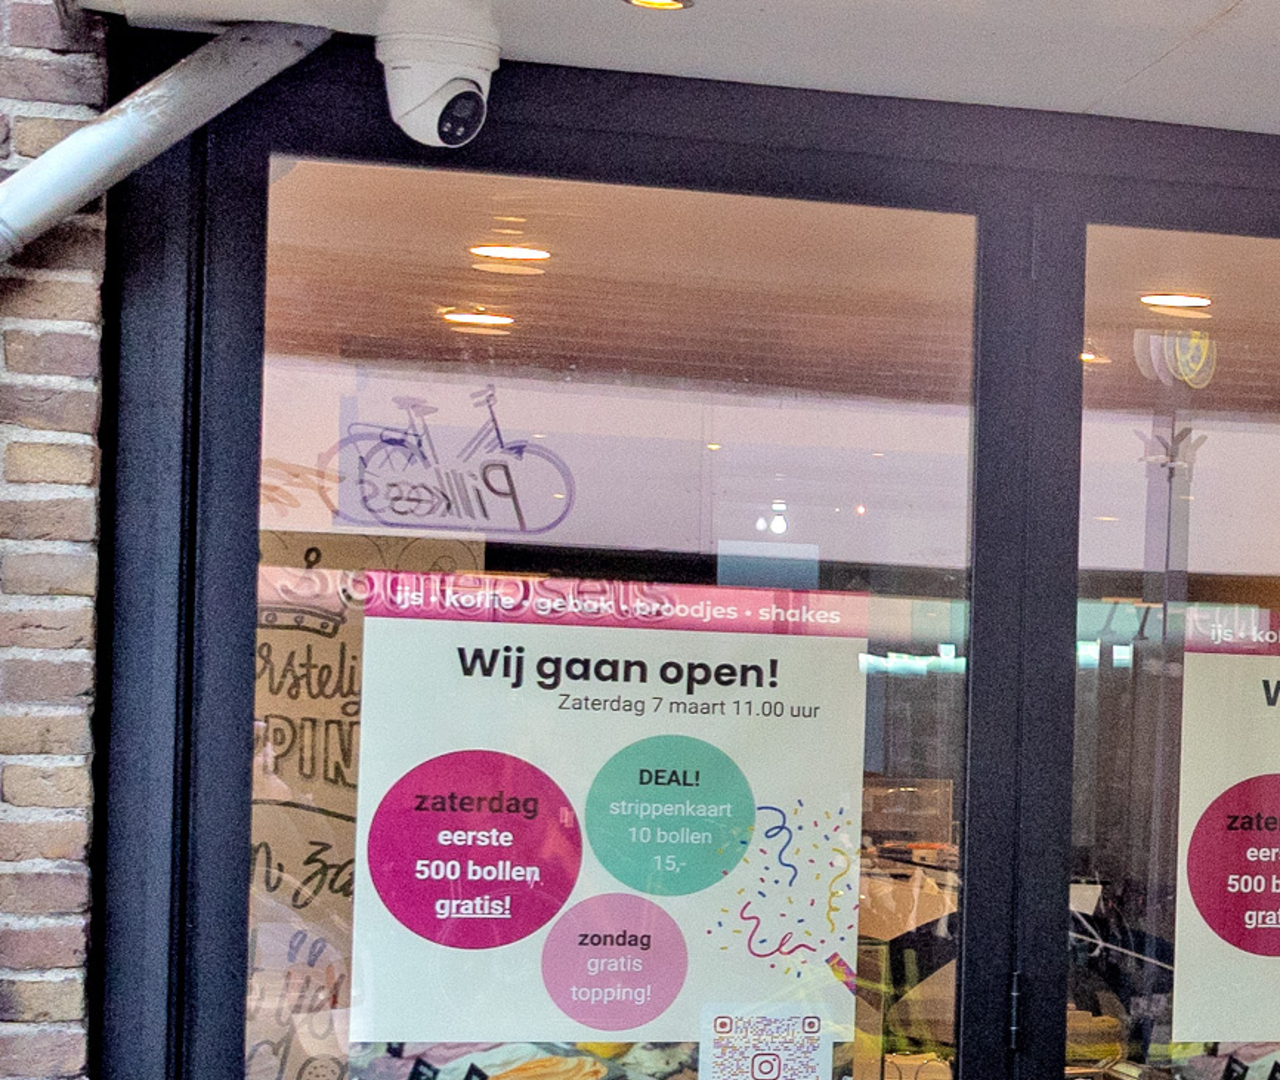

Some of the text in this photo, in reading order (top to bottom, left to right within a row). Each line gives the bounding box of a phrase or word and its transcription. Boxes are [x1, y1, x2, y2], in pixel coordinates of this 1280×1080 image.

[396, 588, 841, 623] ijs koffie gebak broodjes shakes
[1210, 623, 1233, 644] ijs
[457, 645, 779, 694] Wij gaan open!
[558, 694, 821, 718] Zaterdag 7 maart 11.00 uur
[639, 769, 700, 786] DEAL!
[414, 791, 539, 820] zaterdag
[609, 799, 732, 820] strippenkaart
[437, 827, 514, 846] eerste
[629, 827, 712, 845] 10 bollen
[415, 860, 540, 881] 500 bollen
[653, 855, 687, 874] 15,-
[1227, 875, 1265, 893] 500
[435, 896, 512, 919] gratis!
[578, 930, 651, 951] zondag
[587, 956, 643, 975] gratis
[570, 984, 651, 1004] topping!
